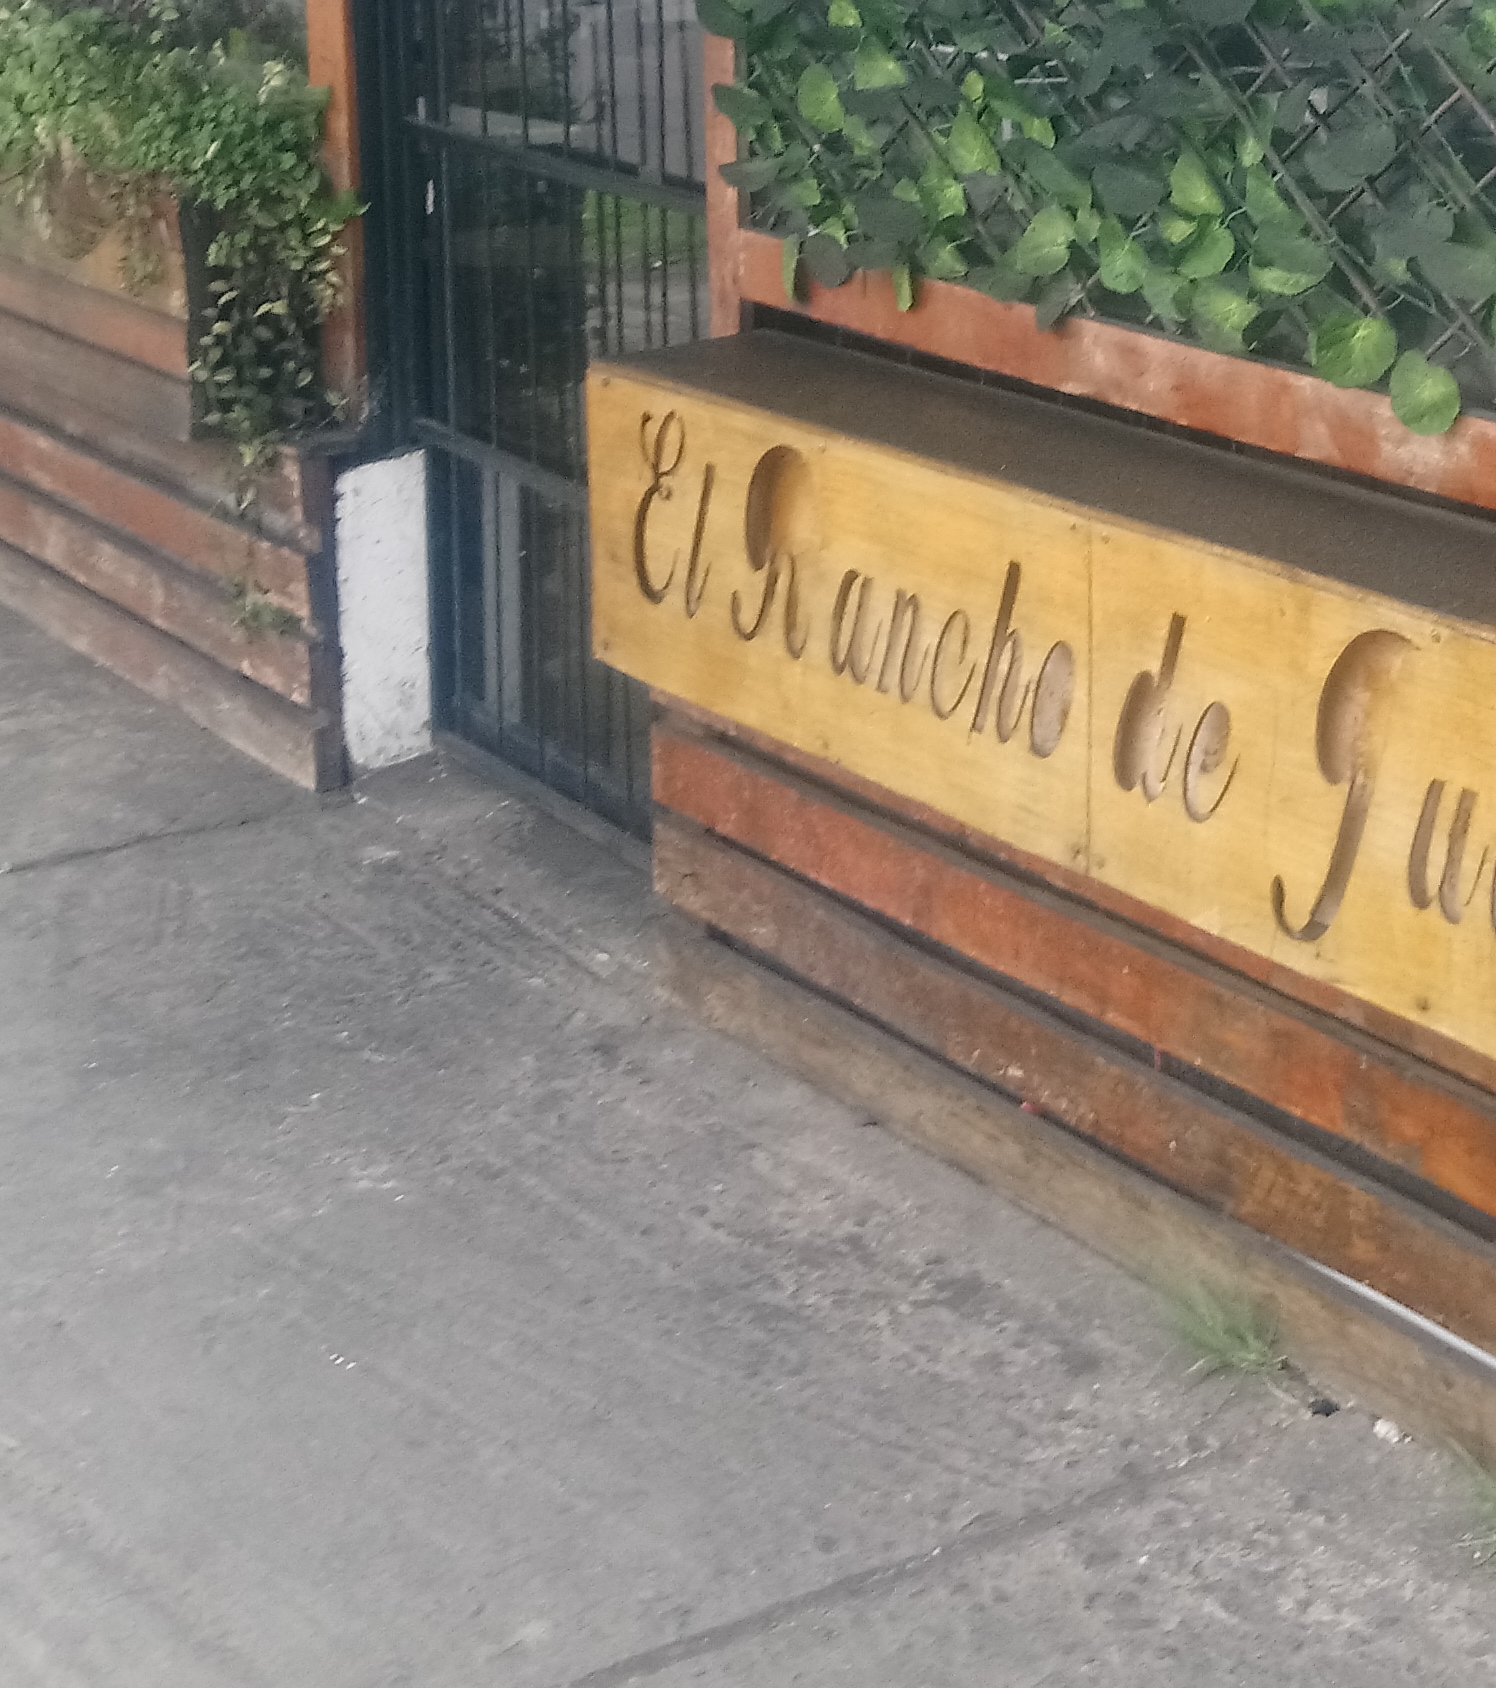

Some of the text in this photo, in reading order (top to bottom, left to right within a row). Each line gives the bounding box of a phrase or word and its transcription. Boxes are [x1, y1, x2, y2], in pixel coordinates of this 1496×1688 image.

[634, 409, 716, 620] El
[730, 443, 1076, 760] Rancho
[1112, 612, 1240, 824] de
